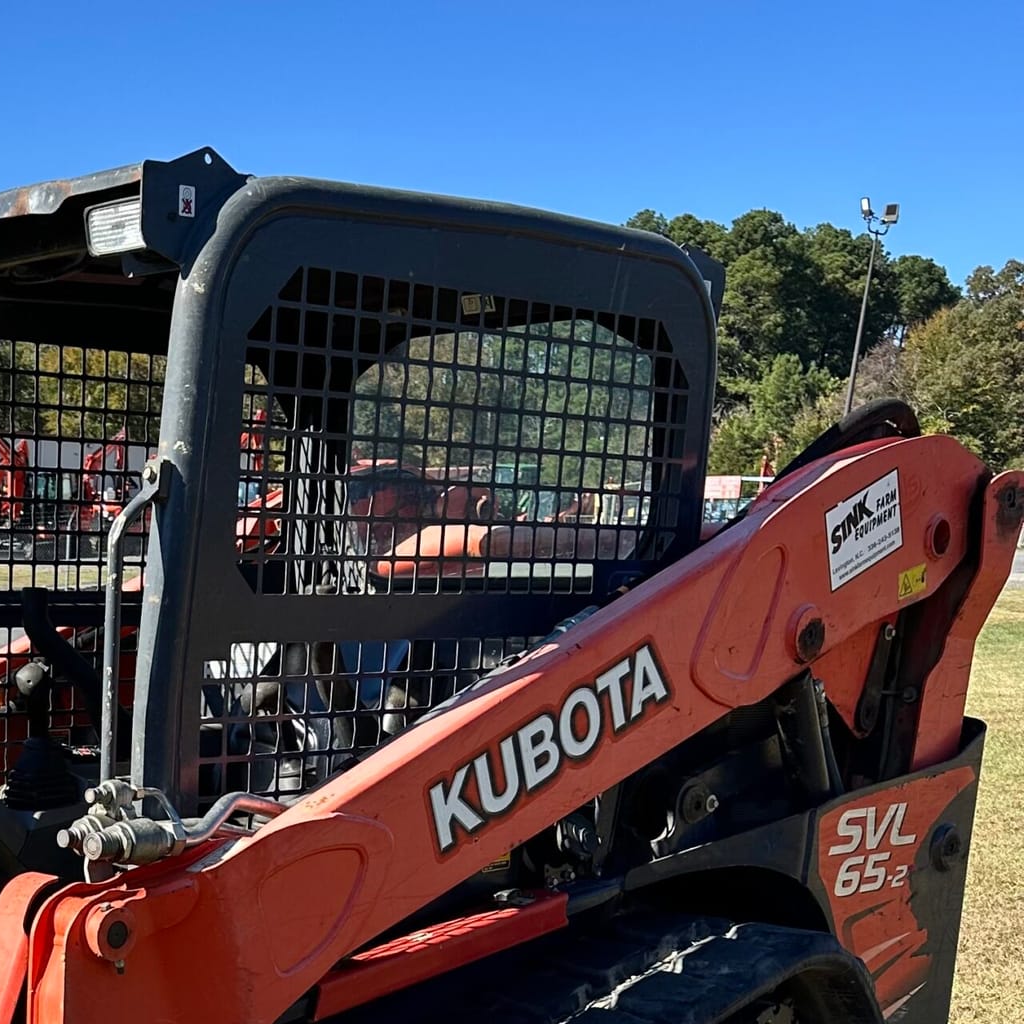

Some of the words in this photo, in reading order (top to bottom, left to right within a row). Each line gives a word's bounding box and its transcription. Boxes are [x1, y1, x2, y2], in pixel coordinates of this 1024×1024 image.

[831, 490, 874, 554] SINK
[876, 488, 897, 511] FARM
[855, 503, 897, 541] EQUIPMENT
[429, 643, 668, 852] KUBOTA
[828, 802, 917, 856] SVL
[834, 851, 908, 897] 65-2
